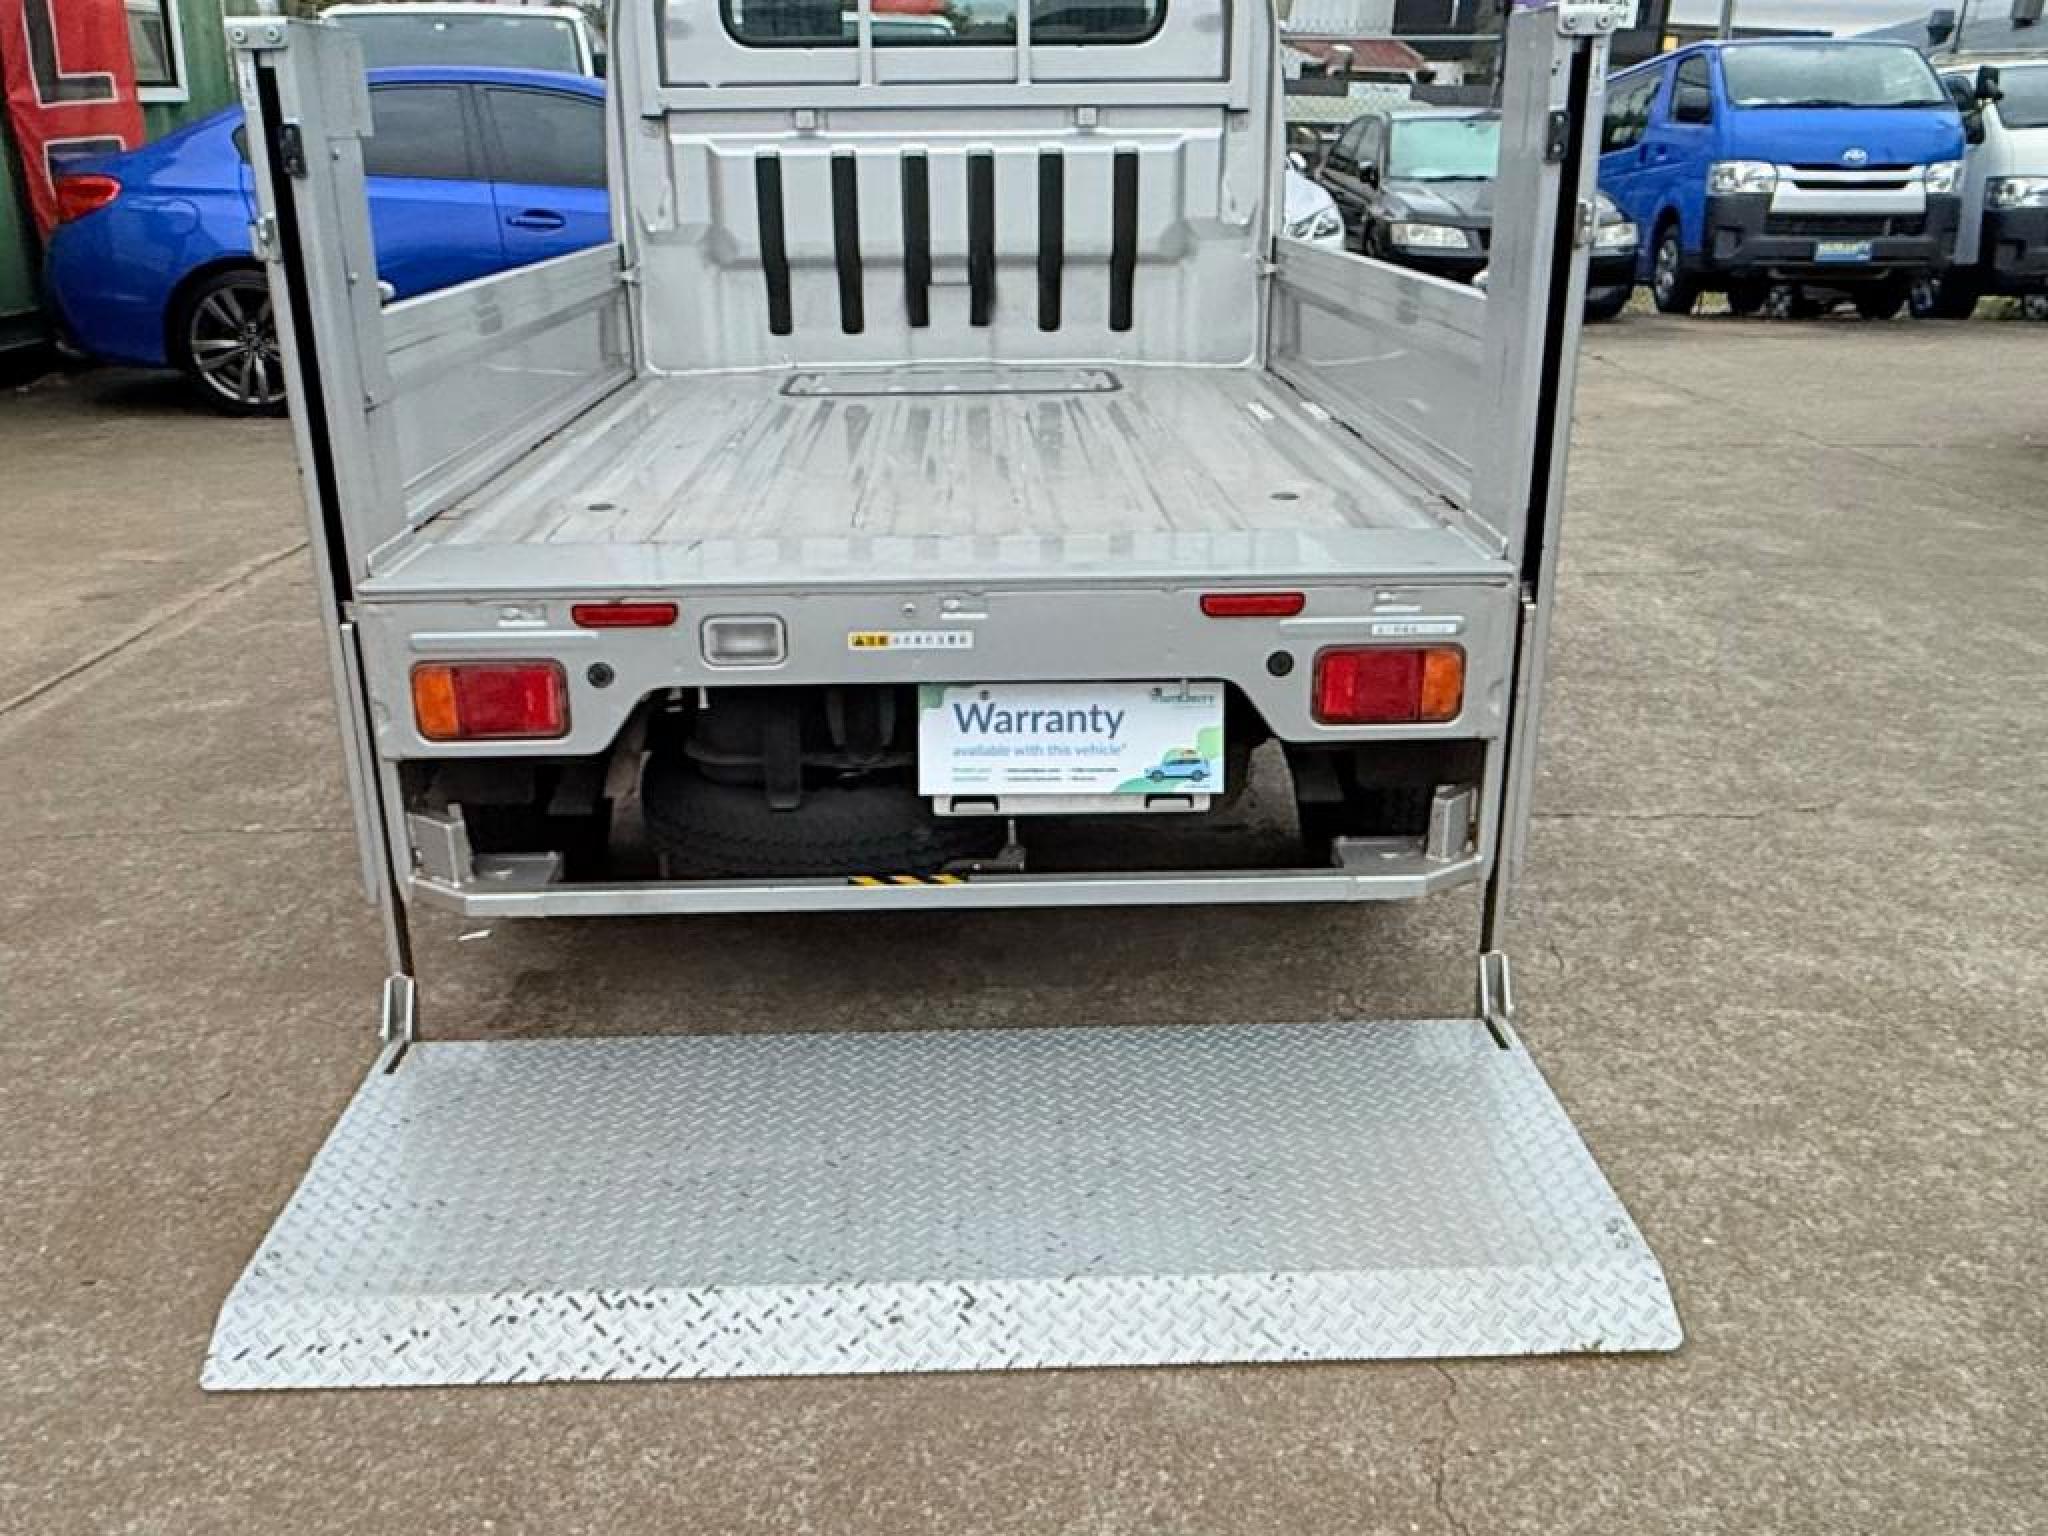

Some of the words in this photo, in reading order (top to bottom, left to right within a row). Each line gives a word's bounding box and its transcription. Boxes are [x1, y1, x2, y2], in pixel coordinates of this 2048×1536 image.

[953, 703, 1125, 739] Warranty
[952, 743, 1010, 756] available
[1013, 743, 1043, 756] with
[1047, 743, 1072, 756] this
